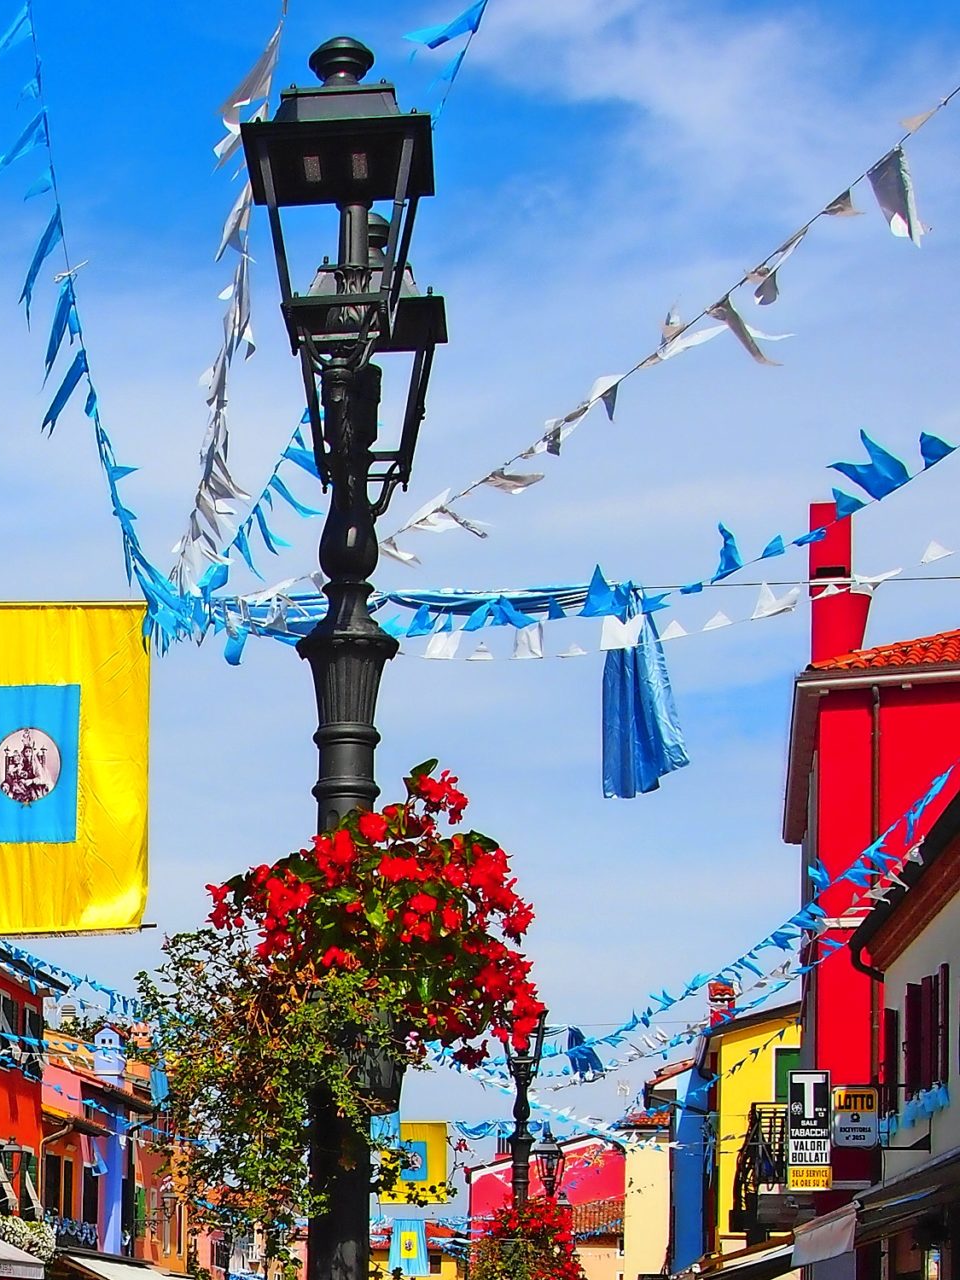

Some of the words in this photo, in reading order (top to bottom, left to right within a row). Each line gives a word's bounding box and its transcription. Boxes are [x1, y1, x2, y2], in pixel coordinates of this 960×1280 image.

[792, 1074, 826, 1118] T
[838, 1094, 874, 1110] LOTTO
[791, 1128, 829, 1137] TABACCHI
[793, 1140, 826, 1151] VALORI
[791, 1152, 828, 1163] BOLLATI
[792, 1169, 804, 1178] SELF
[806, 1169, 828, 1178] SERVICE
[792, 1179, 799, 1187] 24
[800, 1179, 812, 1187] ORE
[813, 1179, 820, 1187] SU
[822, 1179, 829, 1187] 24
